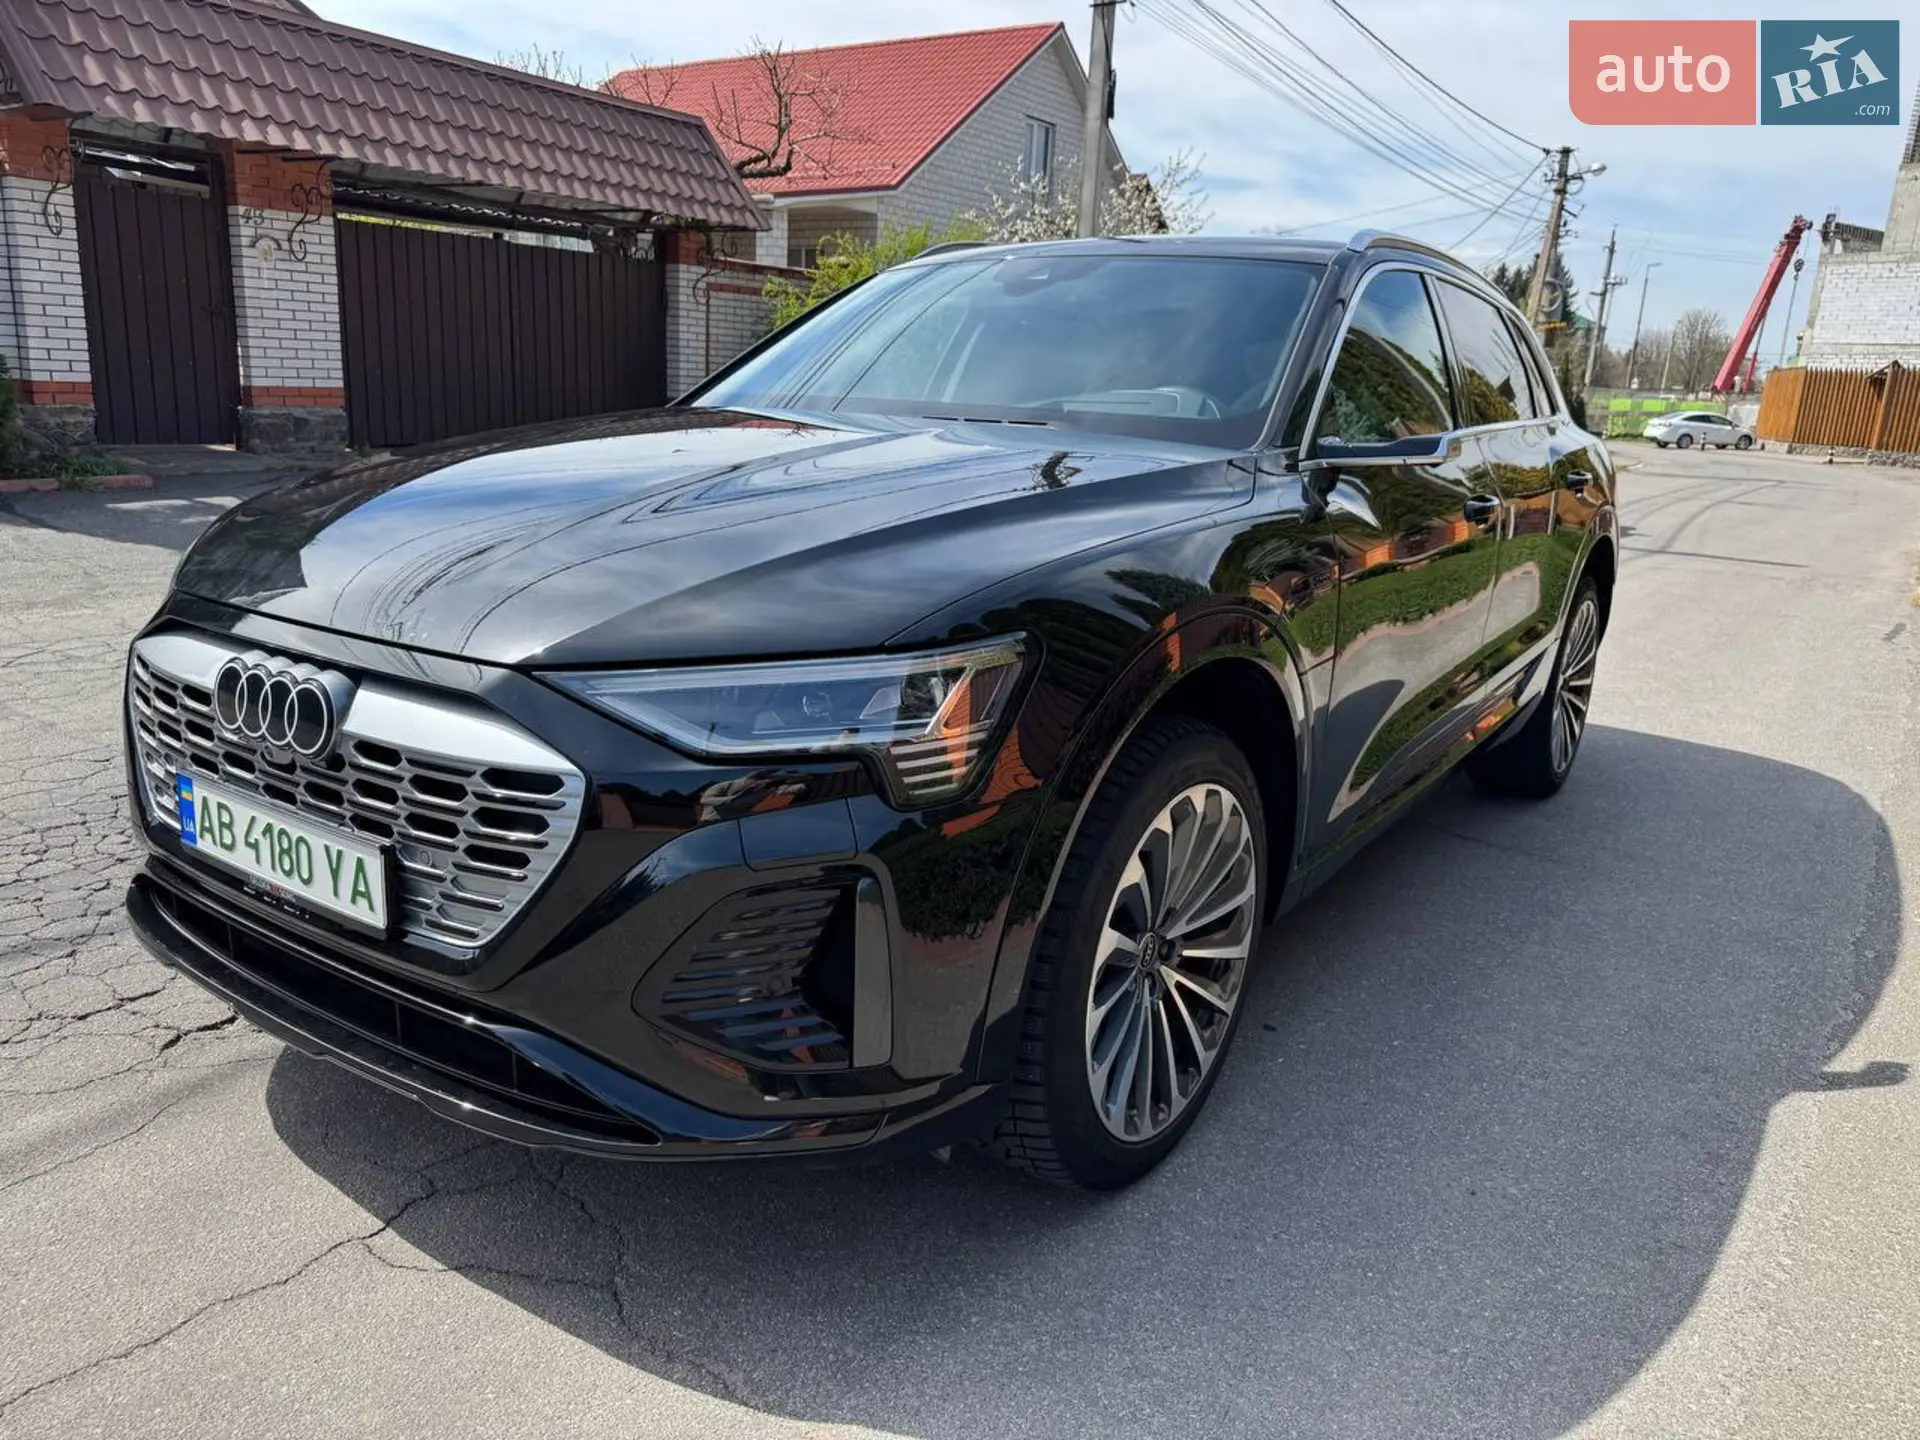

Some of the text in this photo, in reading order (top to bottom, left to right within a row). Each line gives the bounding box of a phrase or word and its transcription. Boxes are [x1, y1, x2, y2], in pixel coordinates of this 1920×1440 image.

[182, 815, 196, 835] UA
[199, 795, 236, 852] AB
[244, 815, 314, 886] 4180
[324, 843, 376, 914] YA
